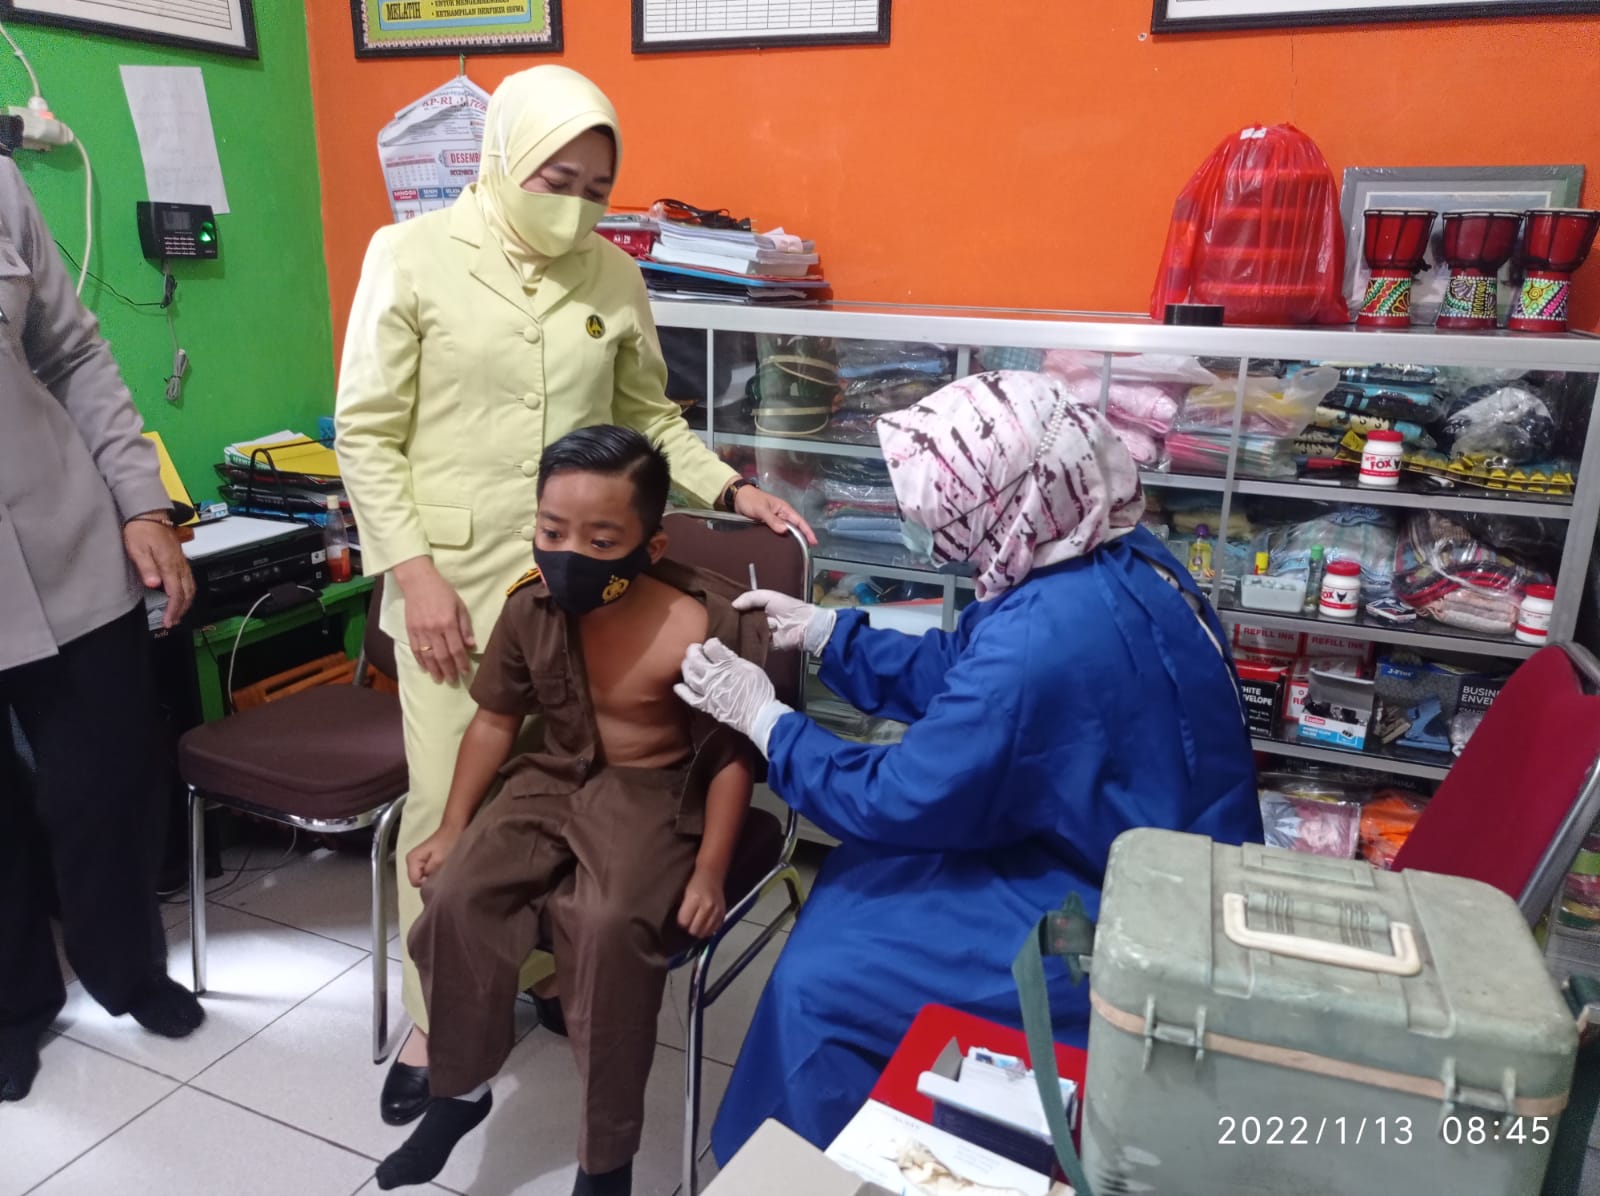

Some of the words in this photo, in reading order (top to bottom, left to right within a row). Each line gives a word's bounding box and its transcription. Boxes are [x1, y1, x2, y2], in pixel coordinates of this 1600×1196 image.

[386, 2, 421, 20] MELATIH
[1370, 459, 1392, 470] FOX
[1243, 626, 1275, 639] REFILL
[1277, 633, 1295, 641] INK
[1311, 636, 1345, 647] REFILL
